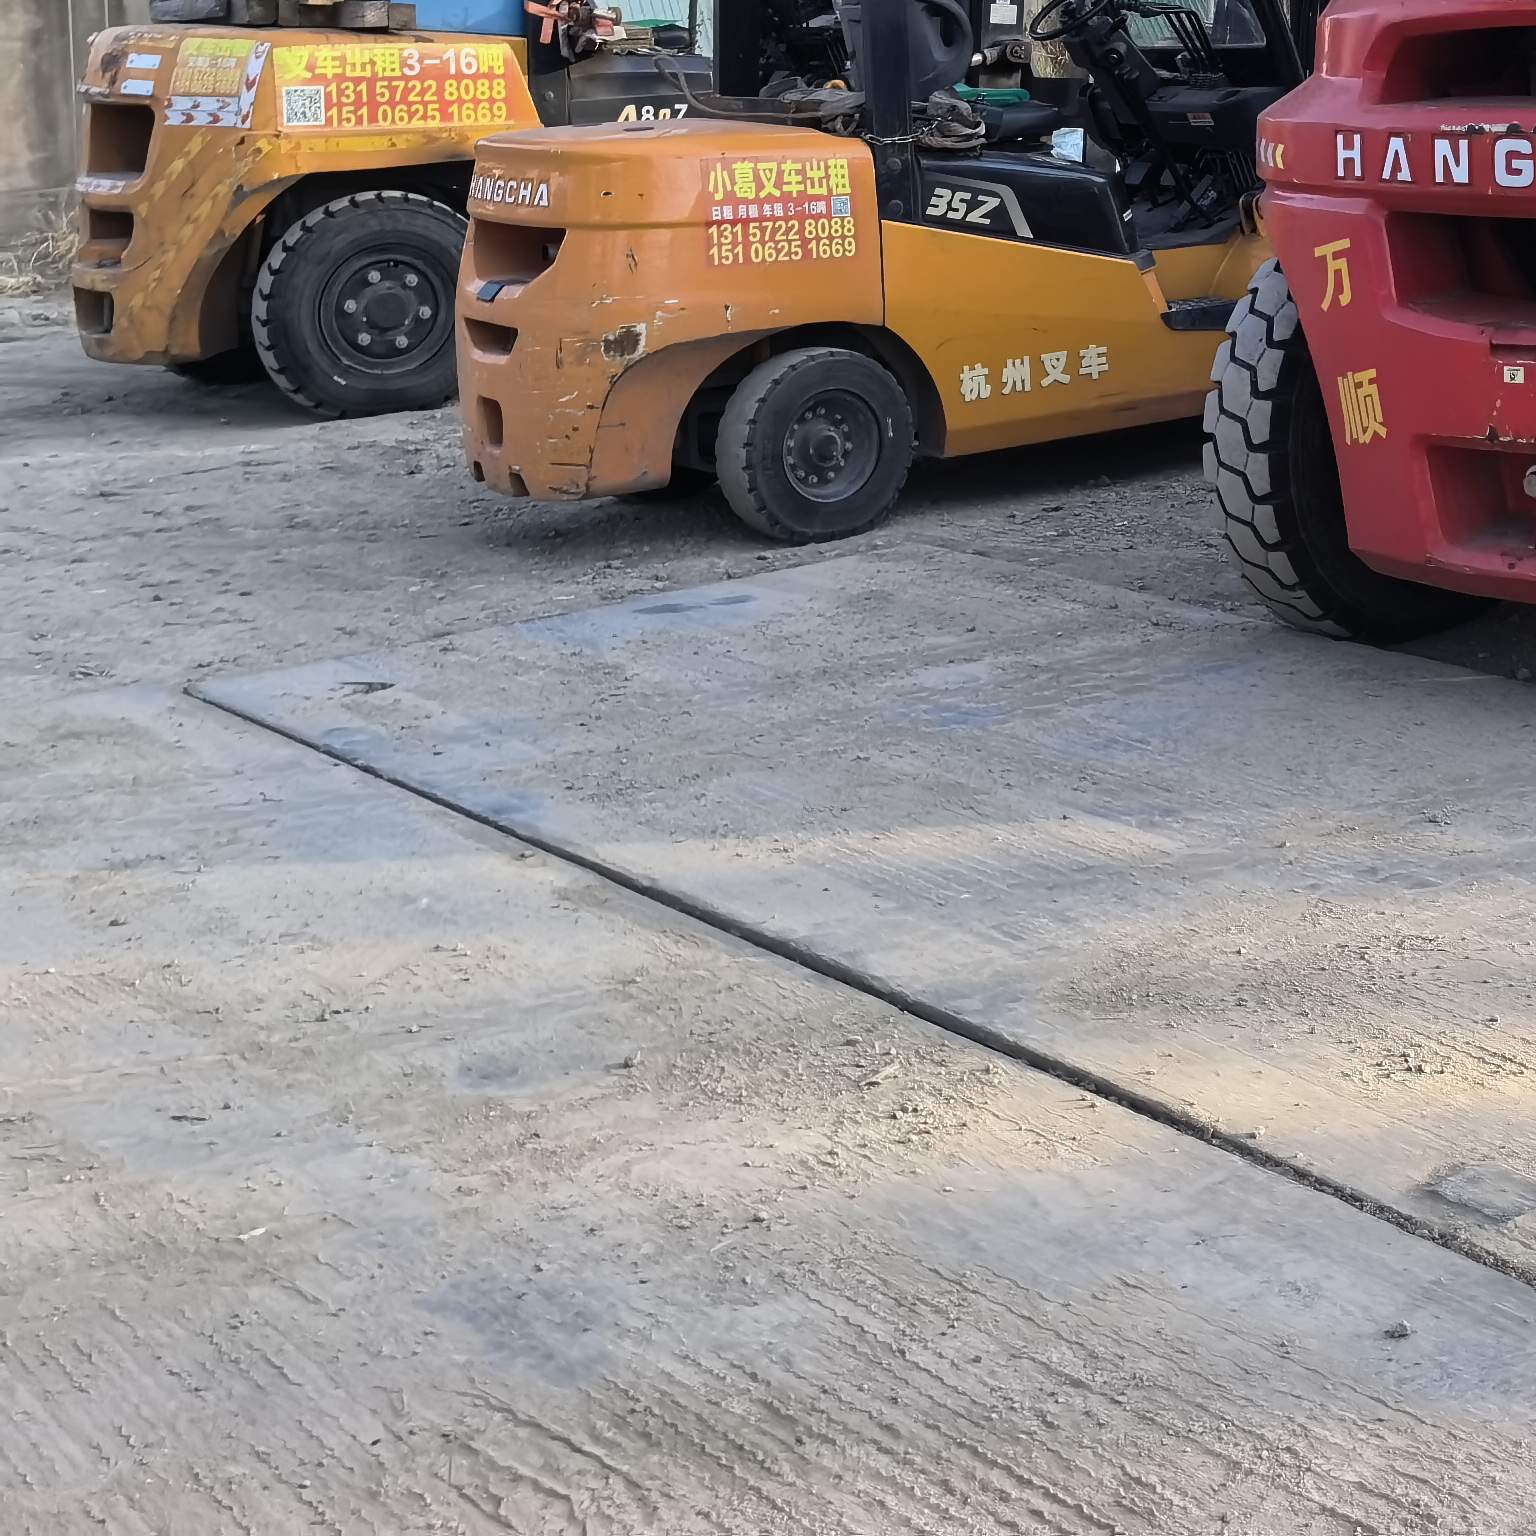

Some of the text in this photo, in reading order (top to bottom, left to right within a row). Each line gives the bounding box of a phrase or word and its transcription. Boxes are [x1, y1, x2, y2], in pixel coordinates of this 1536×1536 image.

[326, 78, 506, 104] 131 5722 8088
[327, 102, 507, 128] 151 0625 1669
[469, 173, 549, 207] HANGCHA
[709, 159, 851, 200] 小葛叉车出租
[708, 217, 855, 244] 131 5722 8088
[709, 237, 856, 265] 151 0625 1669
[959, 344, 1109, 402] 杭州叉车
